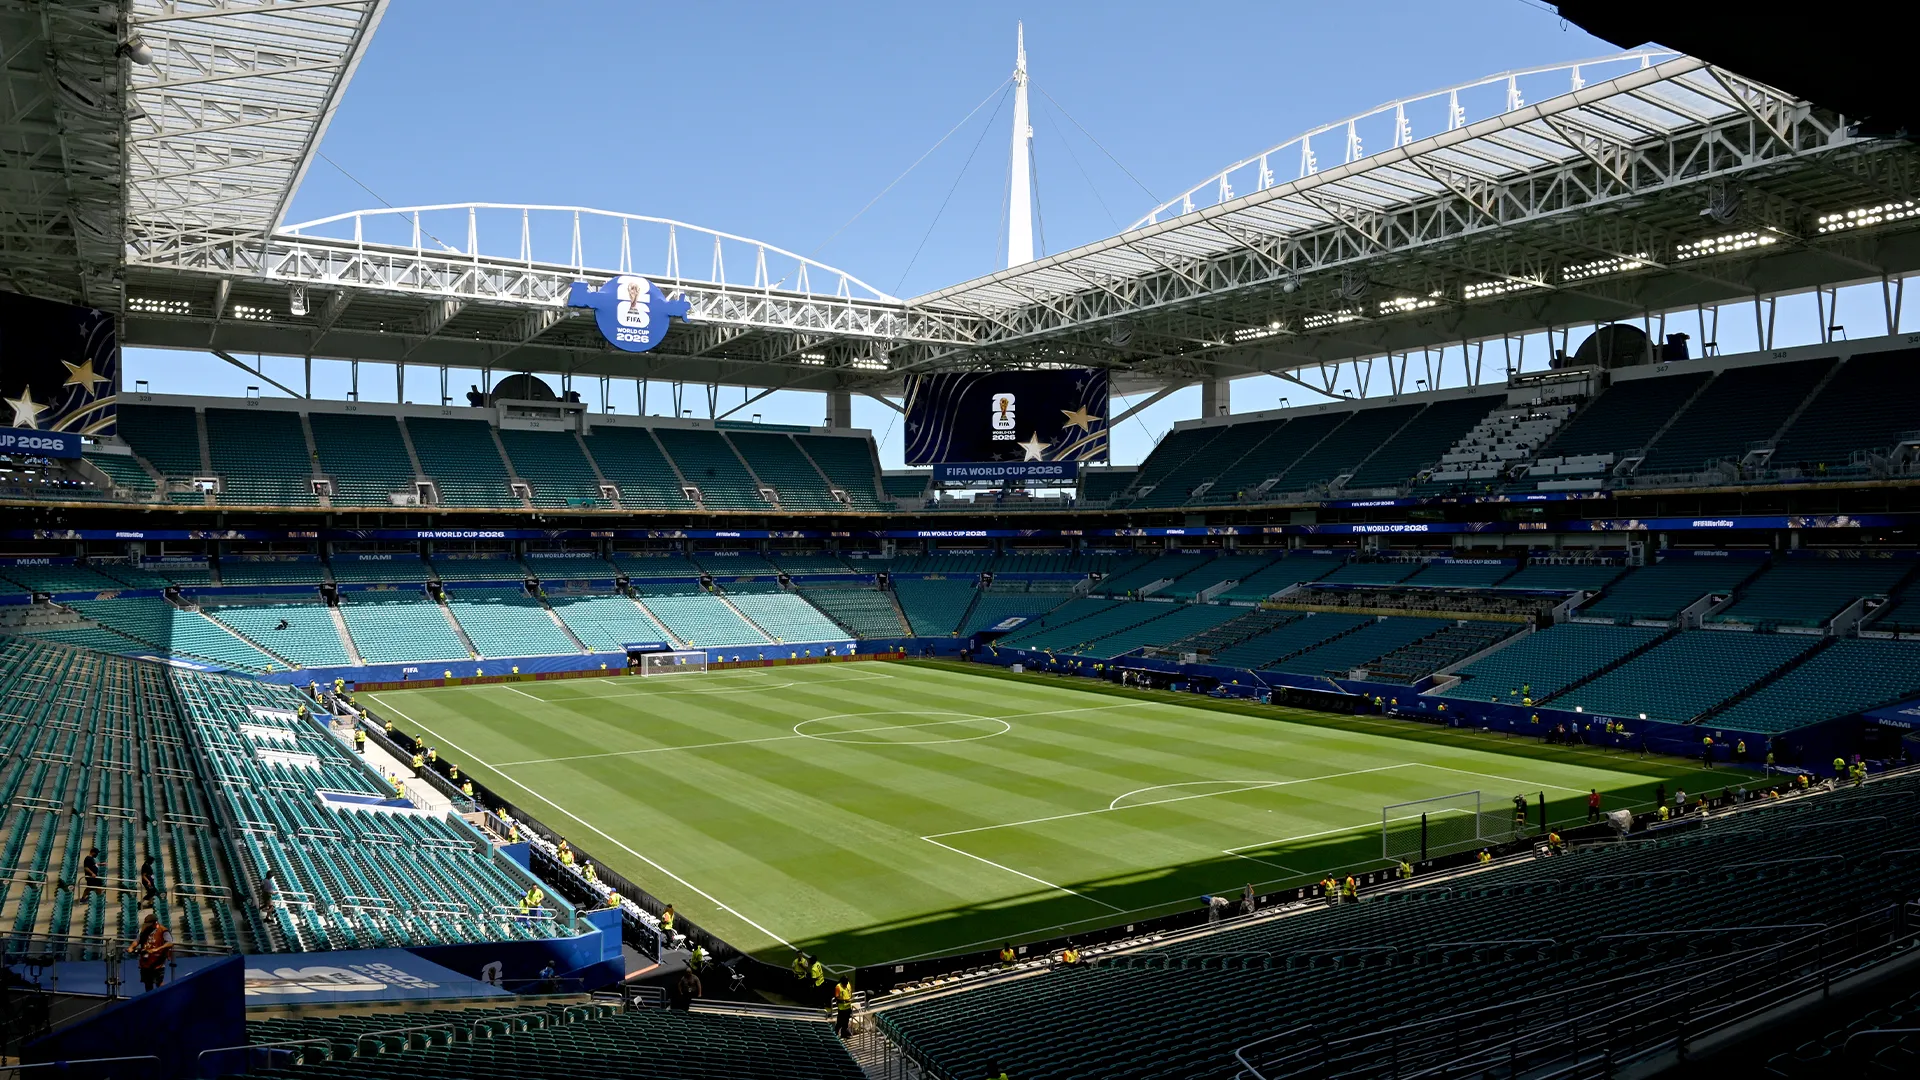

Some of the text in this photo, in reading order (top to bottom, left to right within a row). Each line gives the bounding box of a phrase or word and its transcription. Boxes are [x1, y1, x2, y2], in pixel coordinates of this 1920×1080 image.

[616, 333, 650, 343] 2026
[1773, 352, 1787, 360] 348
[17, 436, 65, 451] 2026
[946, 466, 1063, 476] FIFA WORLD CUP 2026
[1519, 522, 1547, 530] MIAMI
[1593, 716, 1614, 724] FIFA
[1879, 718, 1911, 728] MIAMI
